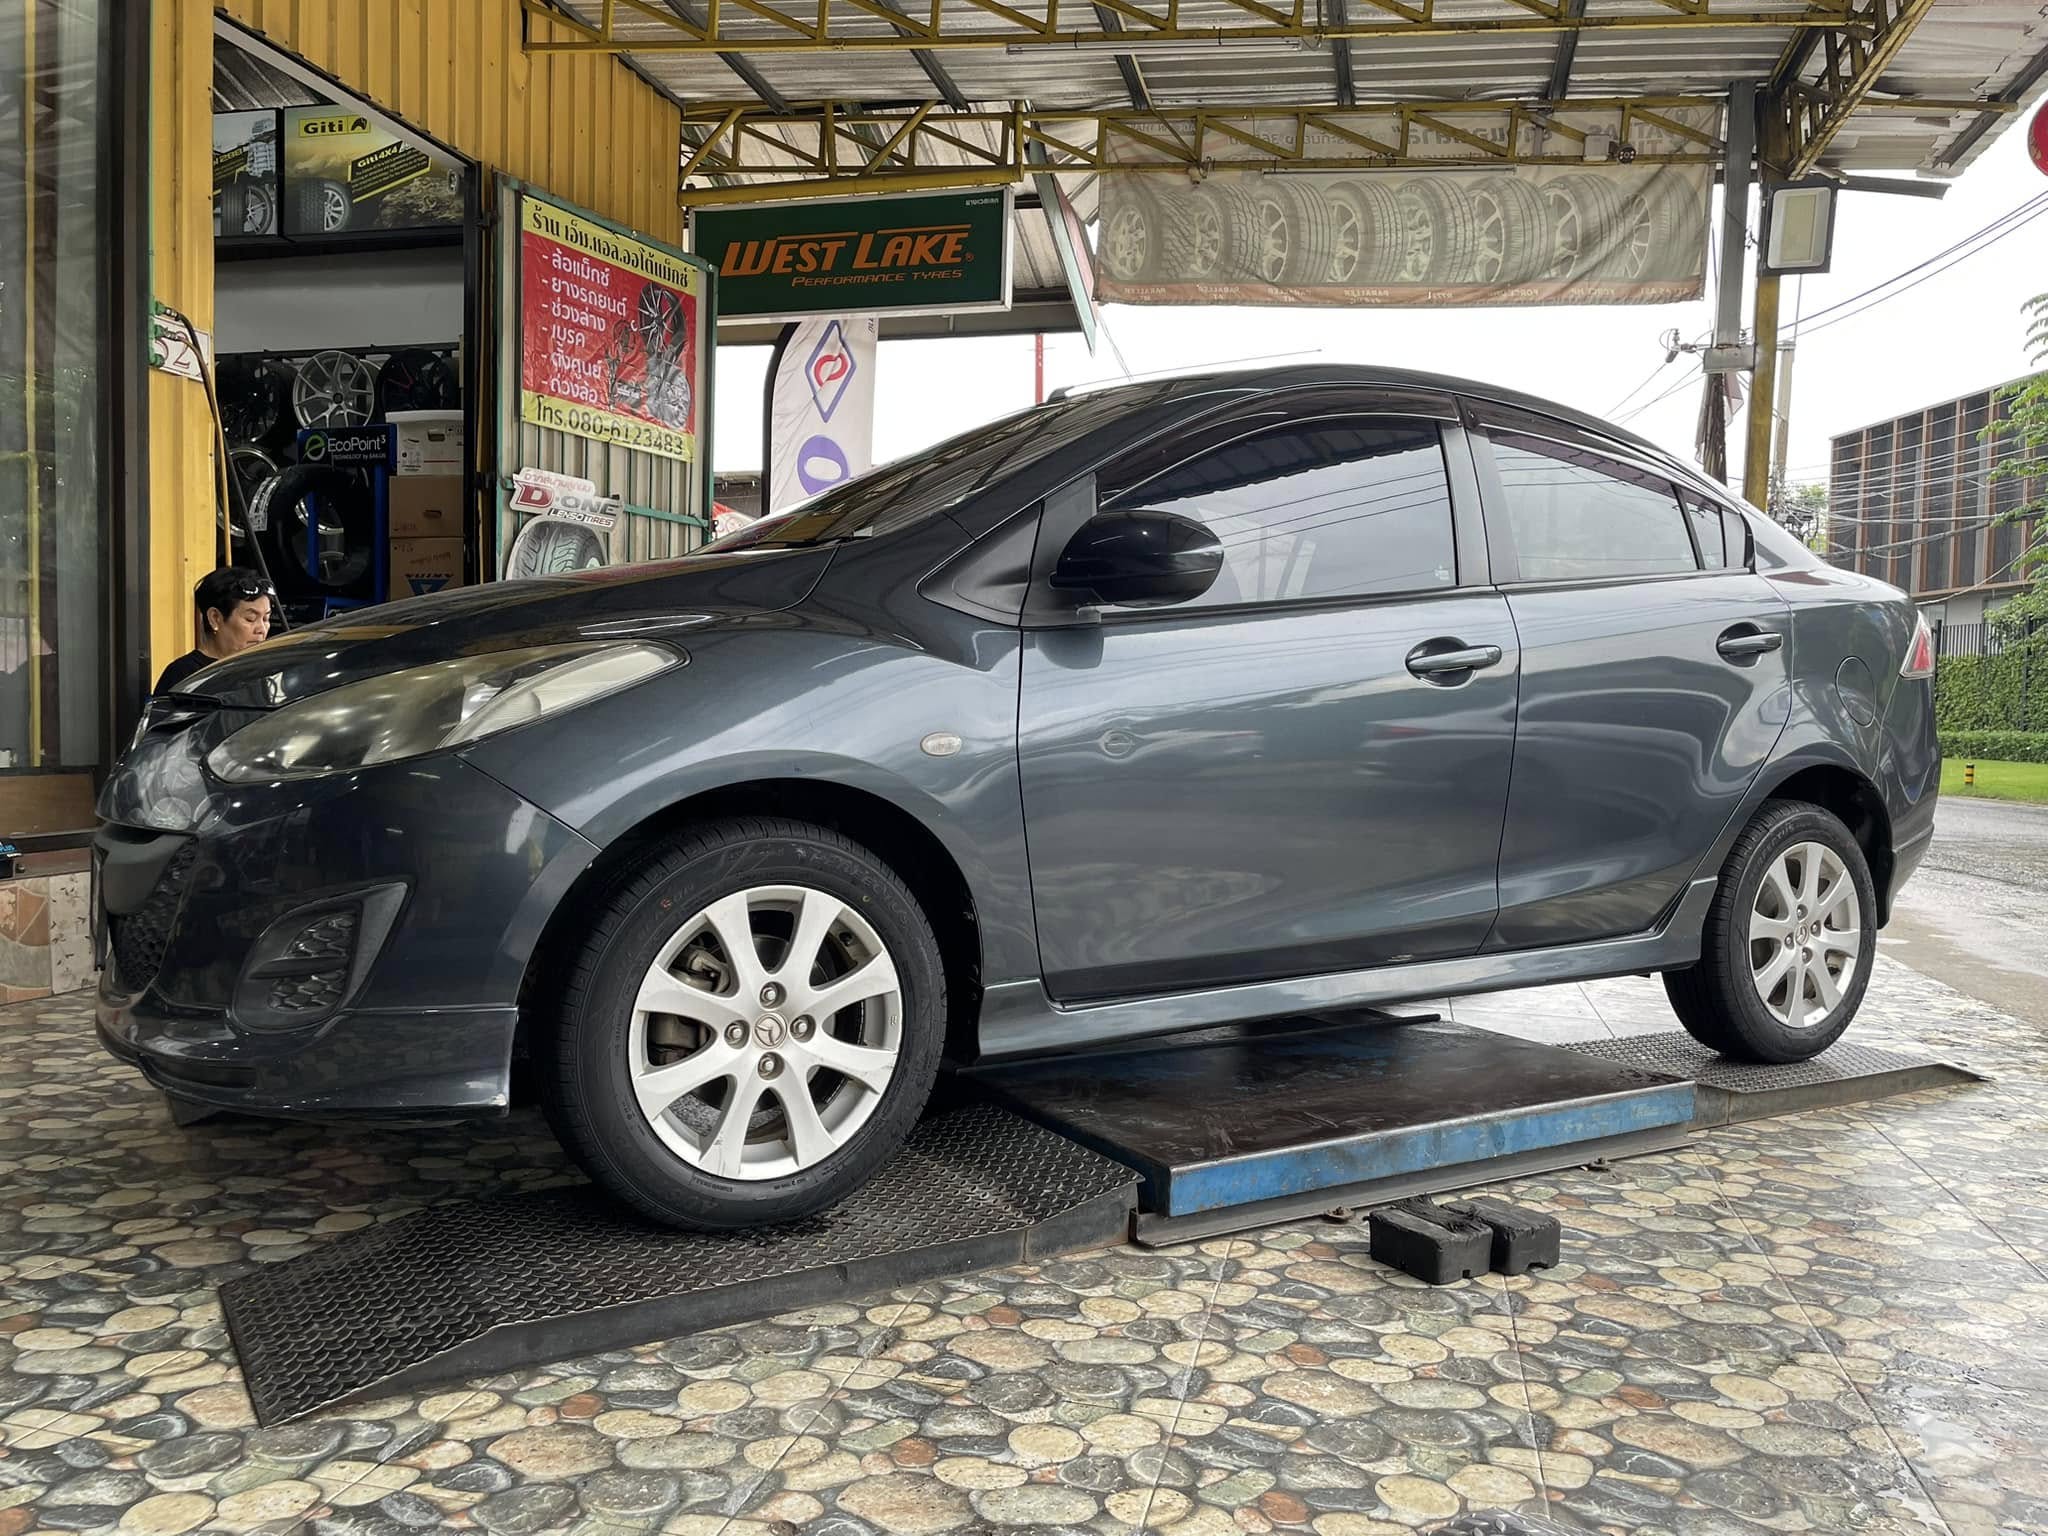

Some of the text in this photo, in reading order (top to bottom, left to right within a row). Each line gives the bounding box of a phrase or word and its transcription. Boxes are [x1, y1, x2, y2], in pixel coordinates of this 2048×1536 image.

[303, 120, 344, 135] Giti
[532, 204, 560, 237] ร้าน
[719, 230, 970, 277] WEST LAKE
[790, 268, 963, 288] PERFORMANCE TYRES
[551, 277, 628, 317] ยางรถยนต์
[551, 297, 606, 332] ช่วงล่าง
[550, 342, 603, 379] ตั้งศูนย์
[550, 374, 599, 403] ถ่วงล้อ
